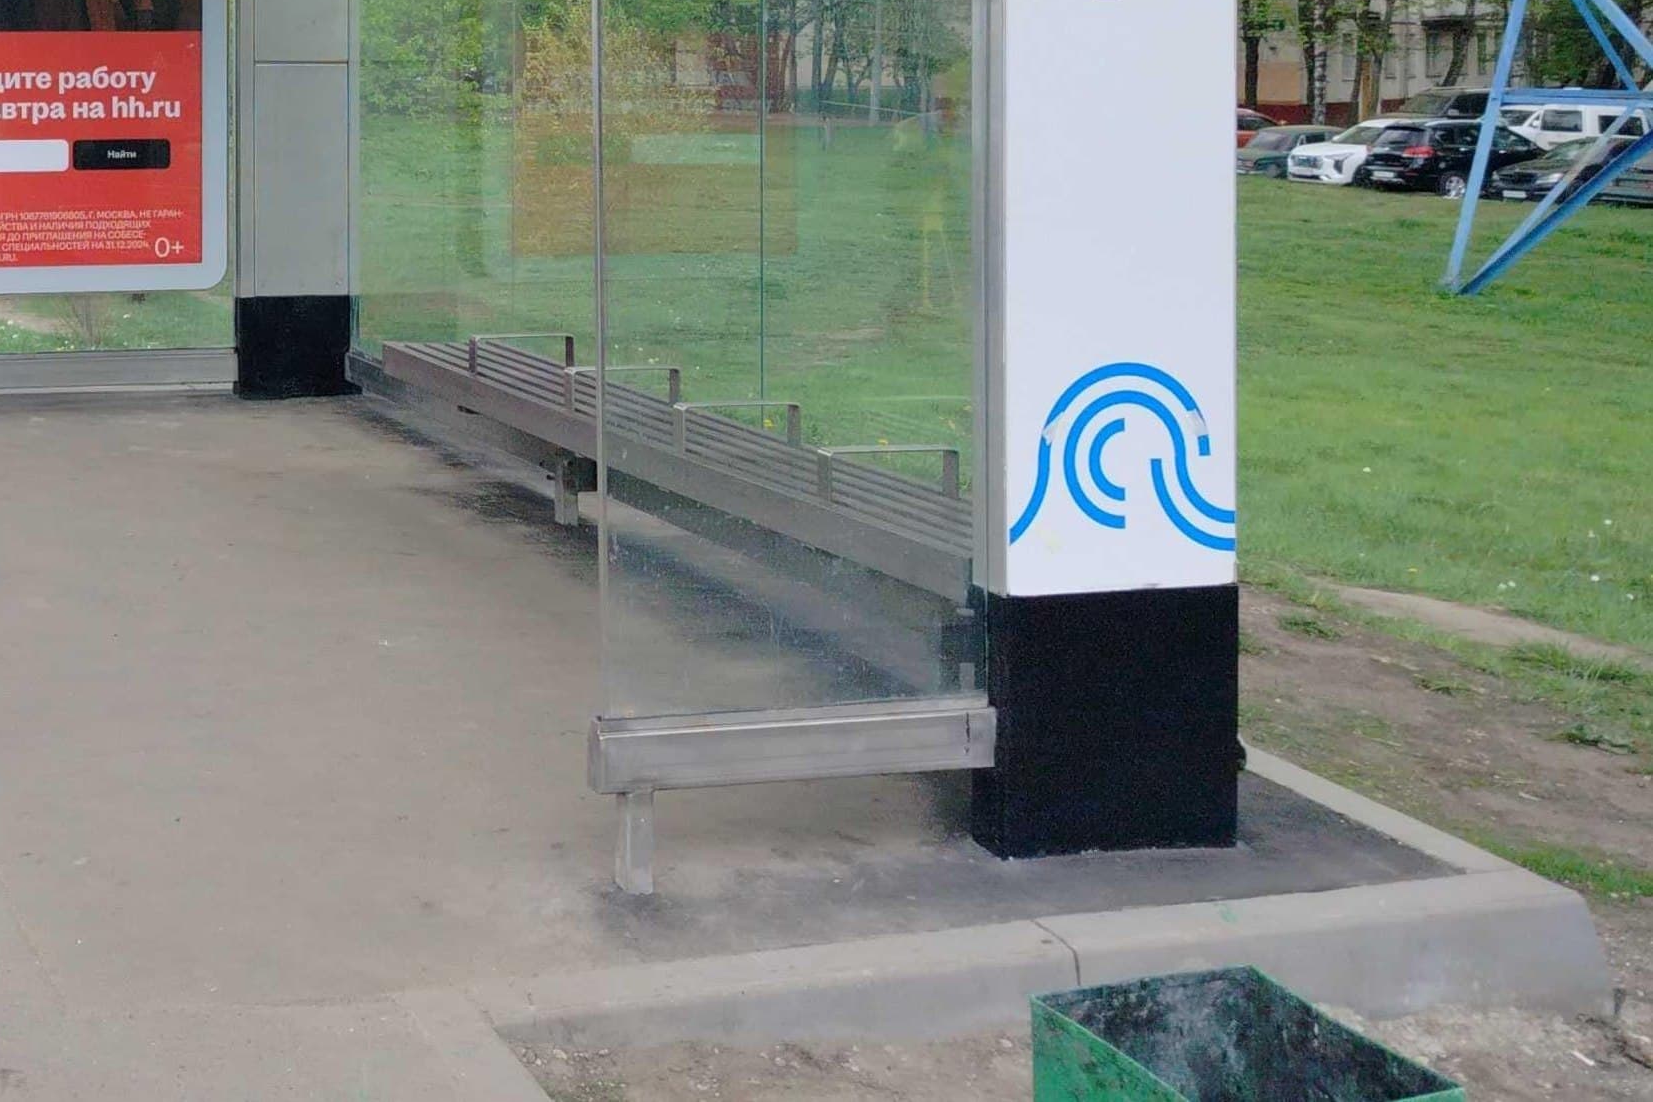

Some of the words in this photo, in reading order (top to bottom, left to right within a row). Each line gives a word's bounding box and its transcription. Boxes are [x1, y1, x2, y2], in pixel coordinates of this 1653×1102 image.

[58, 66, 156, 94] работу
[72, 101, 106, 119] на
[112, 96, 181, 119] hh.ru
[107, 149, 137, 159] Найти
[93, 230, 107, 239] НА
[91, 240, 104, 249] НА
[154, 236, 185, 258] 0+
